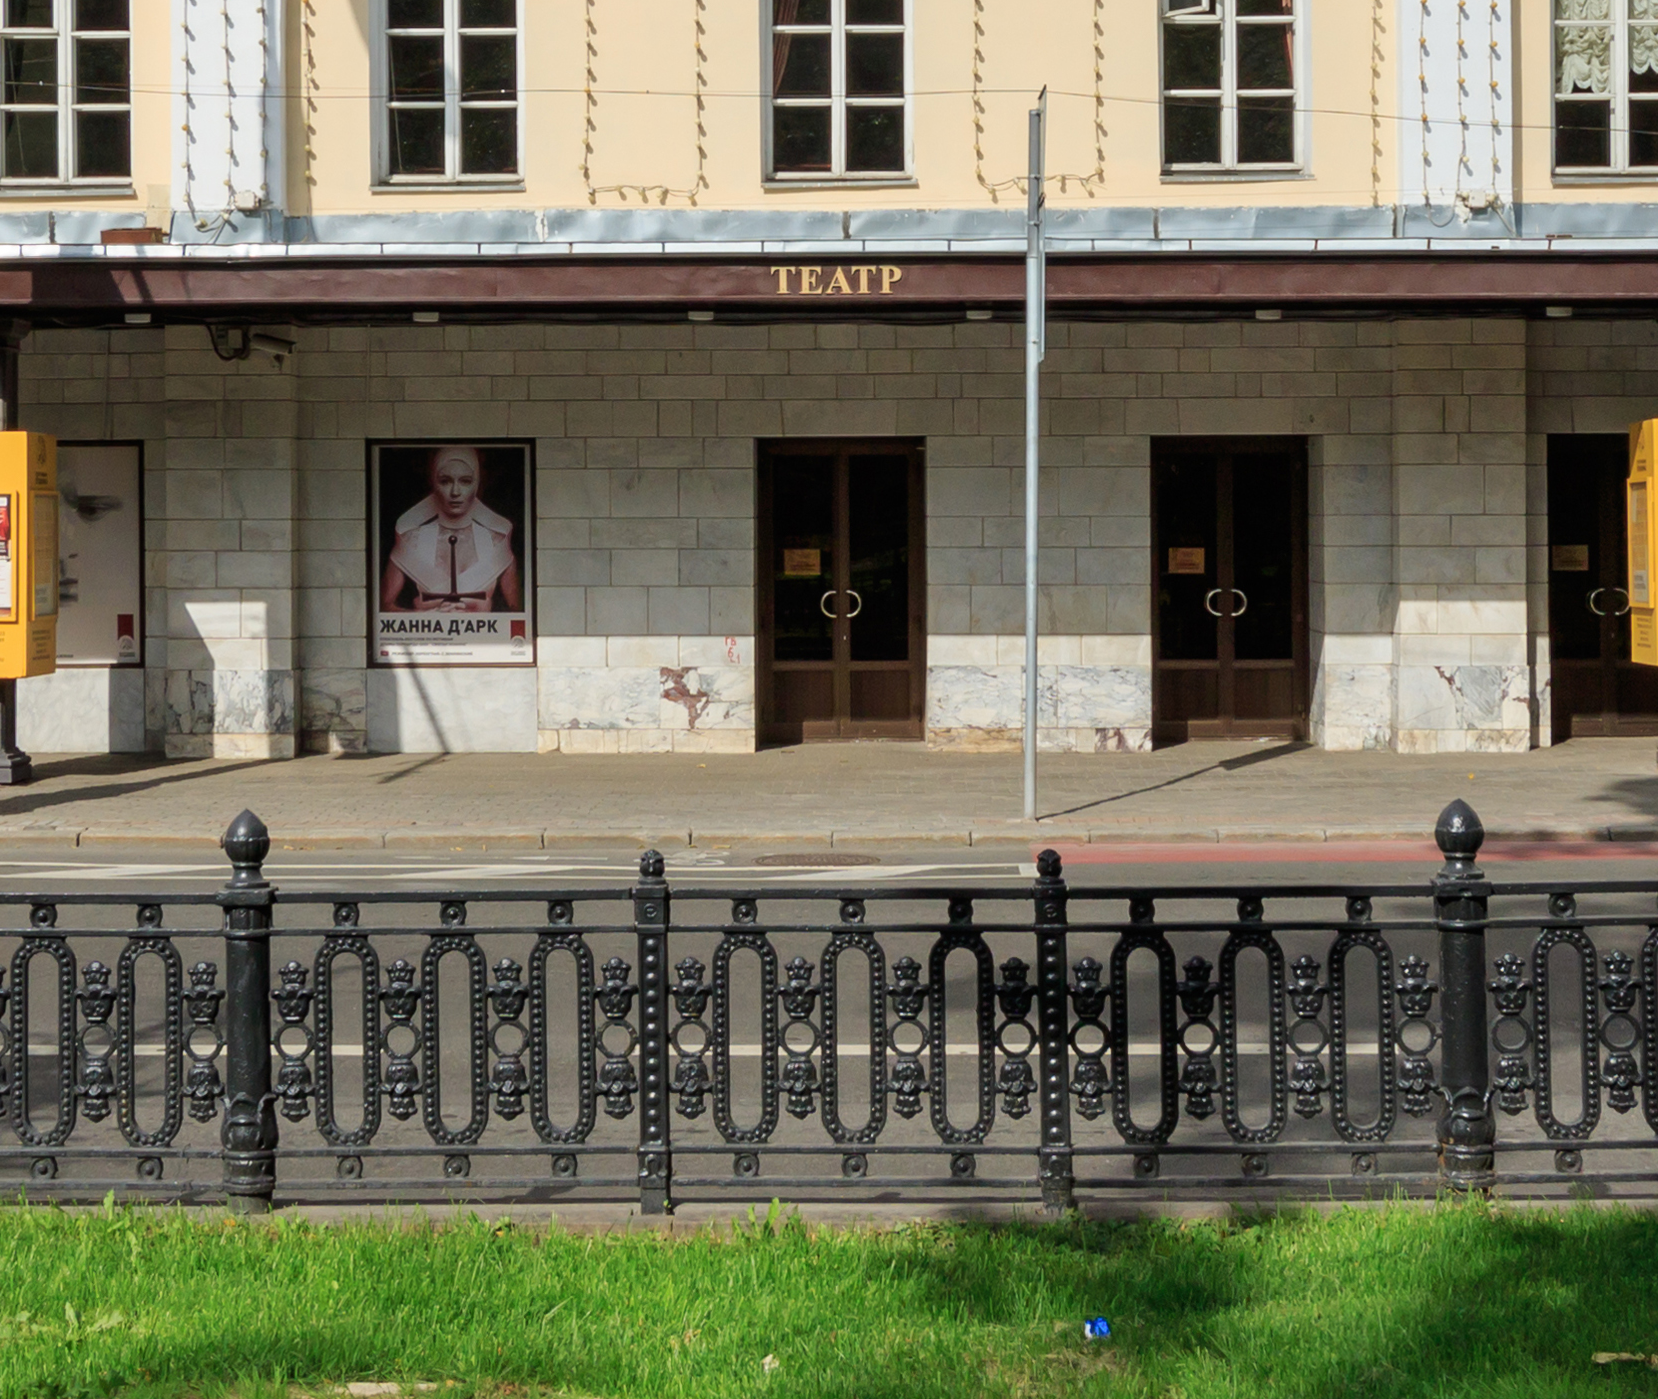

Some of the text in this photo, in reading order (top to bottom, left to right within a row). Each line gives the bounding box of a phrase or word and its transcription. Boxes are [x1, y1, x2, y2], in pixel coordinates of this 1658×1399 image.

[770, 265, 902, 295] ТЕАТР
[380, 619, 498, 635] ЖАННА Д'АРК
